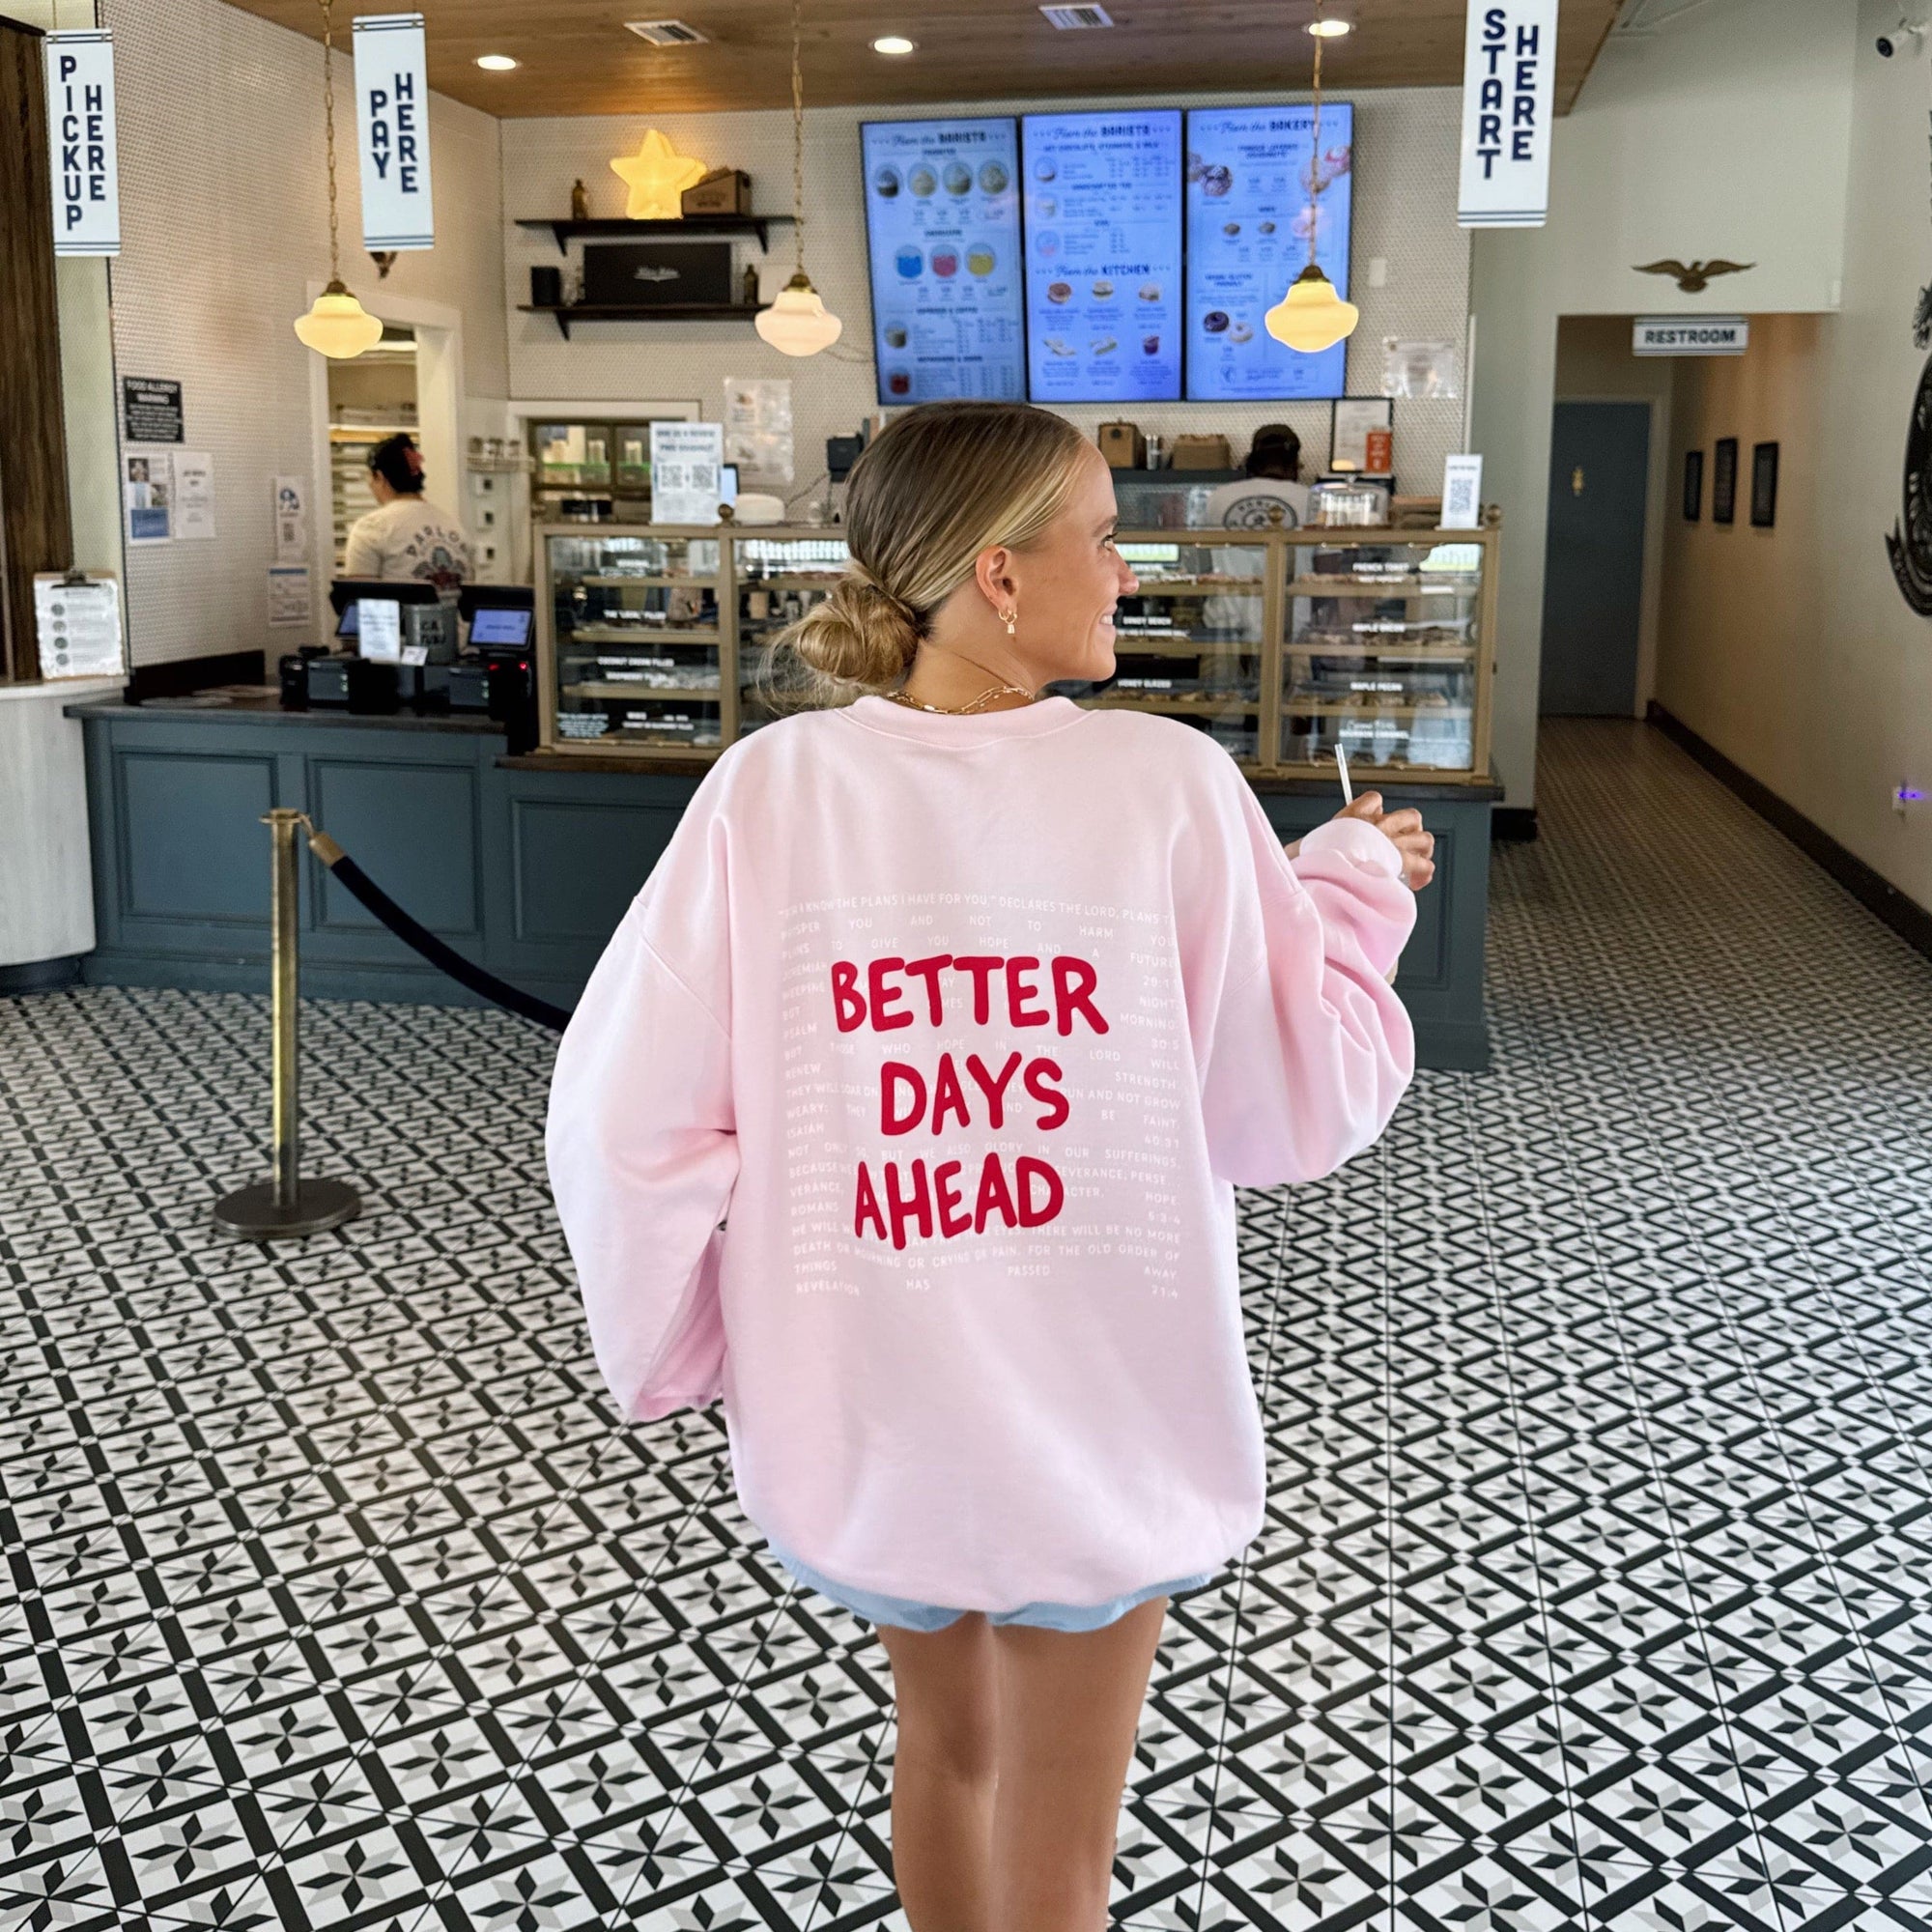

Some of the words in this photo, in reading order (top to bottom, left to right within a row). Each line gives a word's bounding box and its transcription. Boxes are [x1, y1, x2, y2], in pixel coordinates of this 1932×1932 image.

[1477, 8, 1507, 180] START
[1512, 25, 1539, 161] HERE
[60, 55, 83, 231] PICKUP
[85, 84, 106, 201] HERE
[370, 89, 391, 179] PAY
[395, 72, 418, 193] HERE
[1101, 263, 1151, 275] KITCHEN
[1644, 329, 1737, 345] RESTROOM
[806, 899, 834, 913] KNOW
[836, 896, 857, 909] THE
[862, 895, 898, 908] PLANS
[908, 893, 936, 905] HAVE
[939, 893, 961, 905] FOR
[999, 896, 1056, 912] DECLARES
[1059, 901, 1081, 914] THE
[1122, 908, 1159, 924] PLANS
[849, 917, 872, 929] YOU
[910, 914, 933, 926] AND
[969, 915, 992, 927] NOT
[1027, 920, 1042, 932] TO
[1079, 925, 1114, 940] HARM
[831, 940, 844, 952] TO
[871, 937, 898, 950] GIVE
[926, 935, 950, 948] YOU
[979, 936, 1009, 949] HOPE
[1037, 941, 1062, 954] AND
[1091, 948, 1100, 959] A
[832, 954, 1108, 1036] BETTER
[783, 1022, 818, 1040] PSALM
[882, 1042, 911, 1055] WHO
[937, 1038, 965, 1050] HOPE
[995, 1040, 1008, 1052] IN
[1036, 1044, 1059, 1058] THE
[1090, 1049, 1121, 1062] LORD
[1151, 1058, 1179, 1070] WILL
[785, 1063, 821, 1080] RENEW
[1115, 1070, 1176, 1090] STRENGTH
[881, 1052, 1068, 1135] DAYS
[1089, 1089, 1113, 1101] AND
[1118, 1092, 1140, 1105] NOT
[1145, 1095, 1180, 1111] GROW
[1101, 1109, 1116, 1121] BE
[786, 1122, 825, 1139] ISAIAH
[788, 1144, 810, 1159] NOT
[881, 1150, 904, 1161] BUT
[984, 1142, 1023, 1153] GLORY
[1037, 1144, 1050, 1155] IN
[1065, 1146, 1090, 1158] OUR
[788, 1161, 838, 1179] BECAUSE
[790, 1201, 839, 1217] ROMANS
[855, 1152, 1064, 1250] AHEAD
[810, 1221, 838, 1234] WILL
[1072, 1224, 1100, 1236] WILL
[1106, 1225, 1120, 1236] BE
[1125, 1227, 1142, 1237] NO
[1148, 1230, 1180, 1244] MORE
[793, 1240, 831, 1256] DEATH
[907, 1257, 925, 1269] OR
[1028, 1244, 1051, 1256] FOR
[1059, 1244, 1080, 1256] THE
[1089, 1243, 1111, 1255] OLD
[1118, 1244, 1157, 1258] ORDER
[1165, 1249, 1179, 1262] OF
[794, 1260, 838, 1275] THINGS
[906, 1278, 930, 1291] HAS
[1008, 1264, 1051, 1276] PASSED
[1144, 1265, 1178, 1279] AWAY
